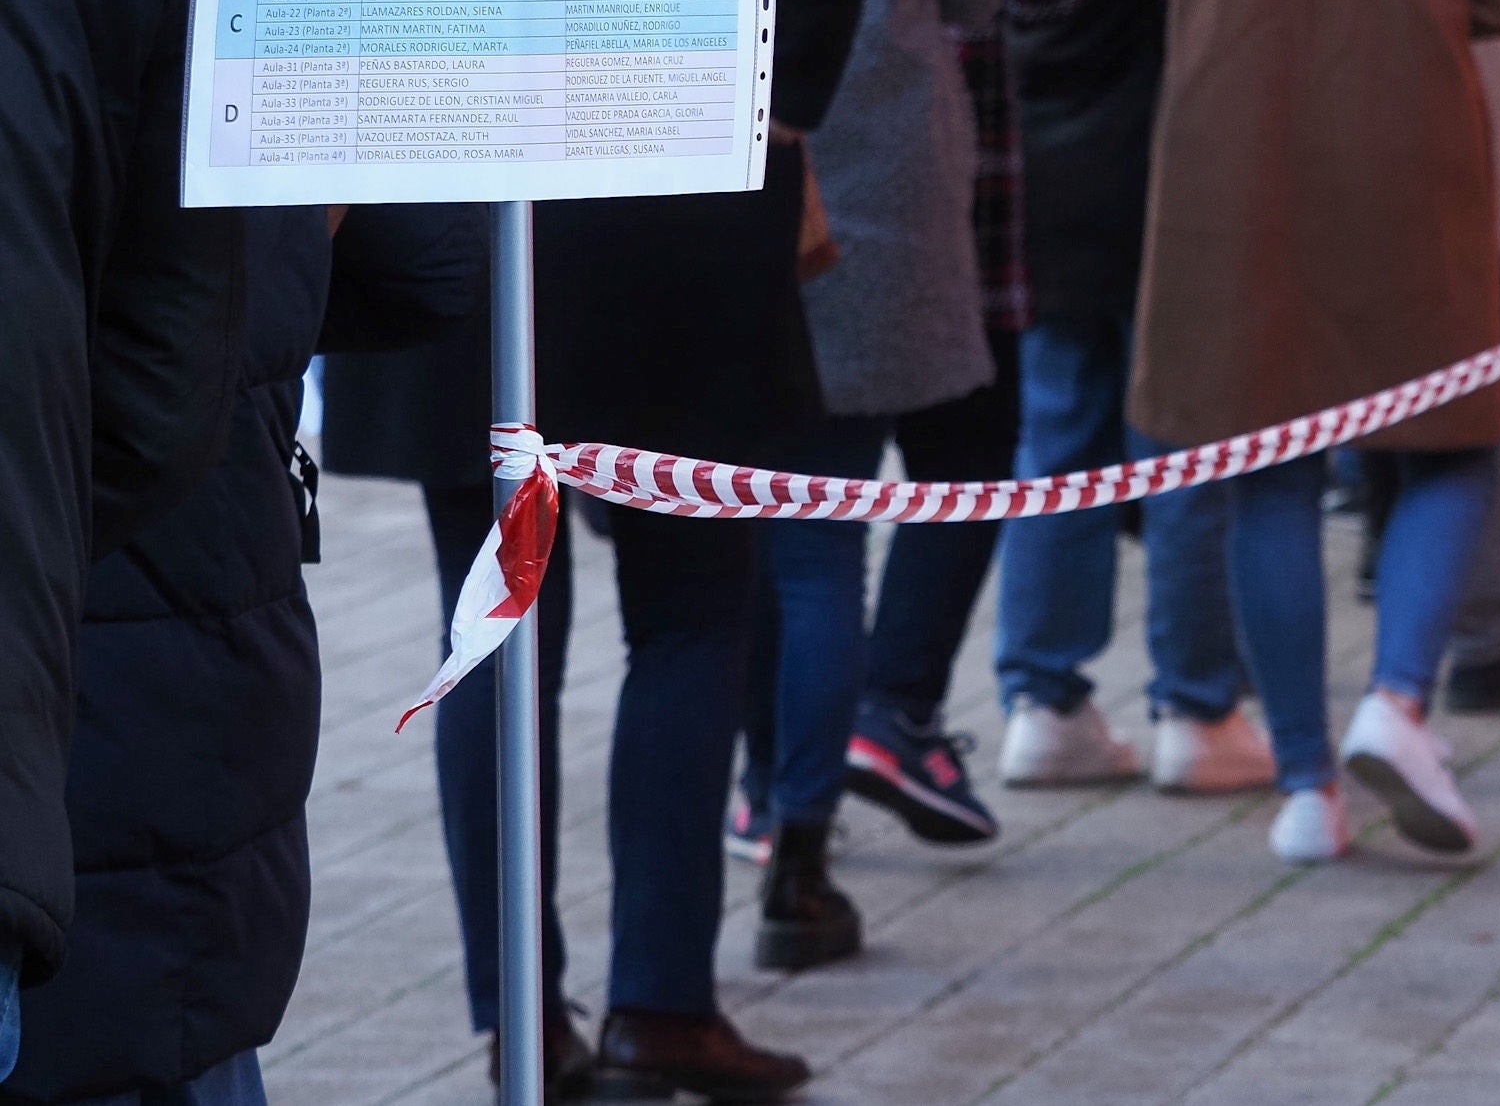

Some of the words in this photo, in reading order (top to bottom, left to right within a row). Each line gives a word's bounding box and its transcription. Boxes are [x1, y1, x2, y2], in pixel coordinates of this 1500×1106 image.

[266, 8, 300, 18] Aula-22
[303, 7, 335, 18] (Planta
[362, 6, 423, 16] LLAMAZARES
[470, 6, 502, 16] SIENA
[566, 4, 594, 14] MARTIN
[644, 3, 680, 13] ENRIQUE
[230, 13, 243, 34] C
[642, 20, 680, 30] RODRIGO
[265, 26, 299, 36] Aula-23
[302, 25, 335, 36] (Planta
[361, 25, 399, 35] MARTIN
[447, 24, 486, 34] FATIMA
[264, 44, 298, 54] Aula-24
[301, 43, 333, 54] (Planta
[360, 42, 407, 53] MORALES
[472, 41, 508, 51] MARTA
[566, 39, 598, 49] PEÑAFIEL
[633, 38, 659, 48] MARIA
[661, 38, 671, 48] DE
[674, 38, 689, 48] LOS
[690, 37, 727, 48] ANGELES
[263, 62, 296, 72] Aula-31
[300, 61, 332, 72] (Planta
[360, 60, 391, 70] PEÑAS
[452, 60, 485, 70] LAURA
[566, 58, 600, 68] REGUERA
[634, 57, 661, 67] MARIA
[662, 56, 684, 66] CRUZ
[262, 79, 296, 90] Aula-32
[299, 79, 332, 90] (Planta
[359, 78, 404, 88] REGUERA
[430, 78, 468, 88] SERGIO
[261, 98, 296, 108] Aula-33
[298, 97, 331, 108] (Planta
[359, 96, 415, 106] RODRIGUEZ
[418, 96, 430, 106] DE
[466, 95, 510, 105] CRISTIAN
[512, 95, 544, 105] MIGUEL
[224, 104, 238, 124] D
[358, 114, 426, 124] SANTAMARTA
[495, 113, 519, 122] RAUL
[260, 116, 295, 126] Aula-34
[298, 115, 330, 126] (Planta
[260, 133, 295, 144] Aula-35
[297, 133, 329, 144] (Planta
[358, 132, 403, 142] VAZQUEZ
[461, 131, 488, 141] RUTH
[357, 150, 406, 160] VIDRIALES
[463, 149, 491, 159] ROSA
[494, 149, 524, 159] MARIA
